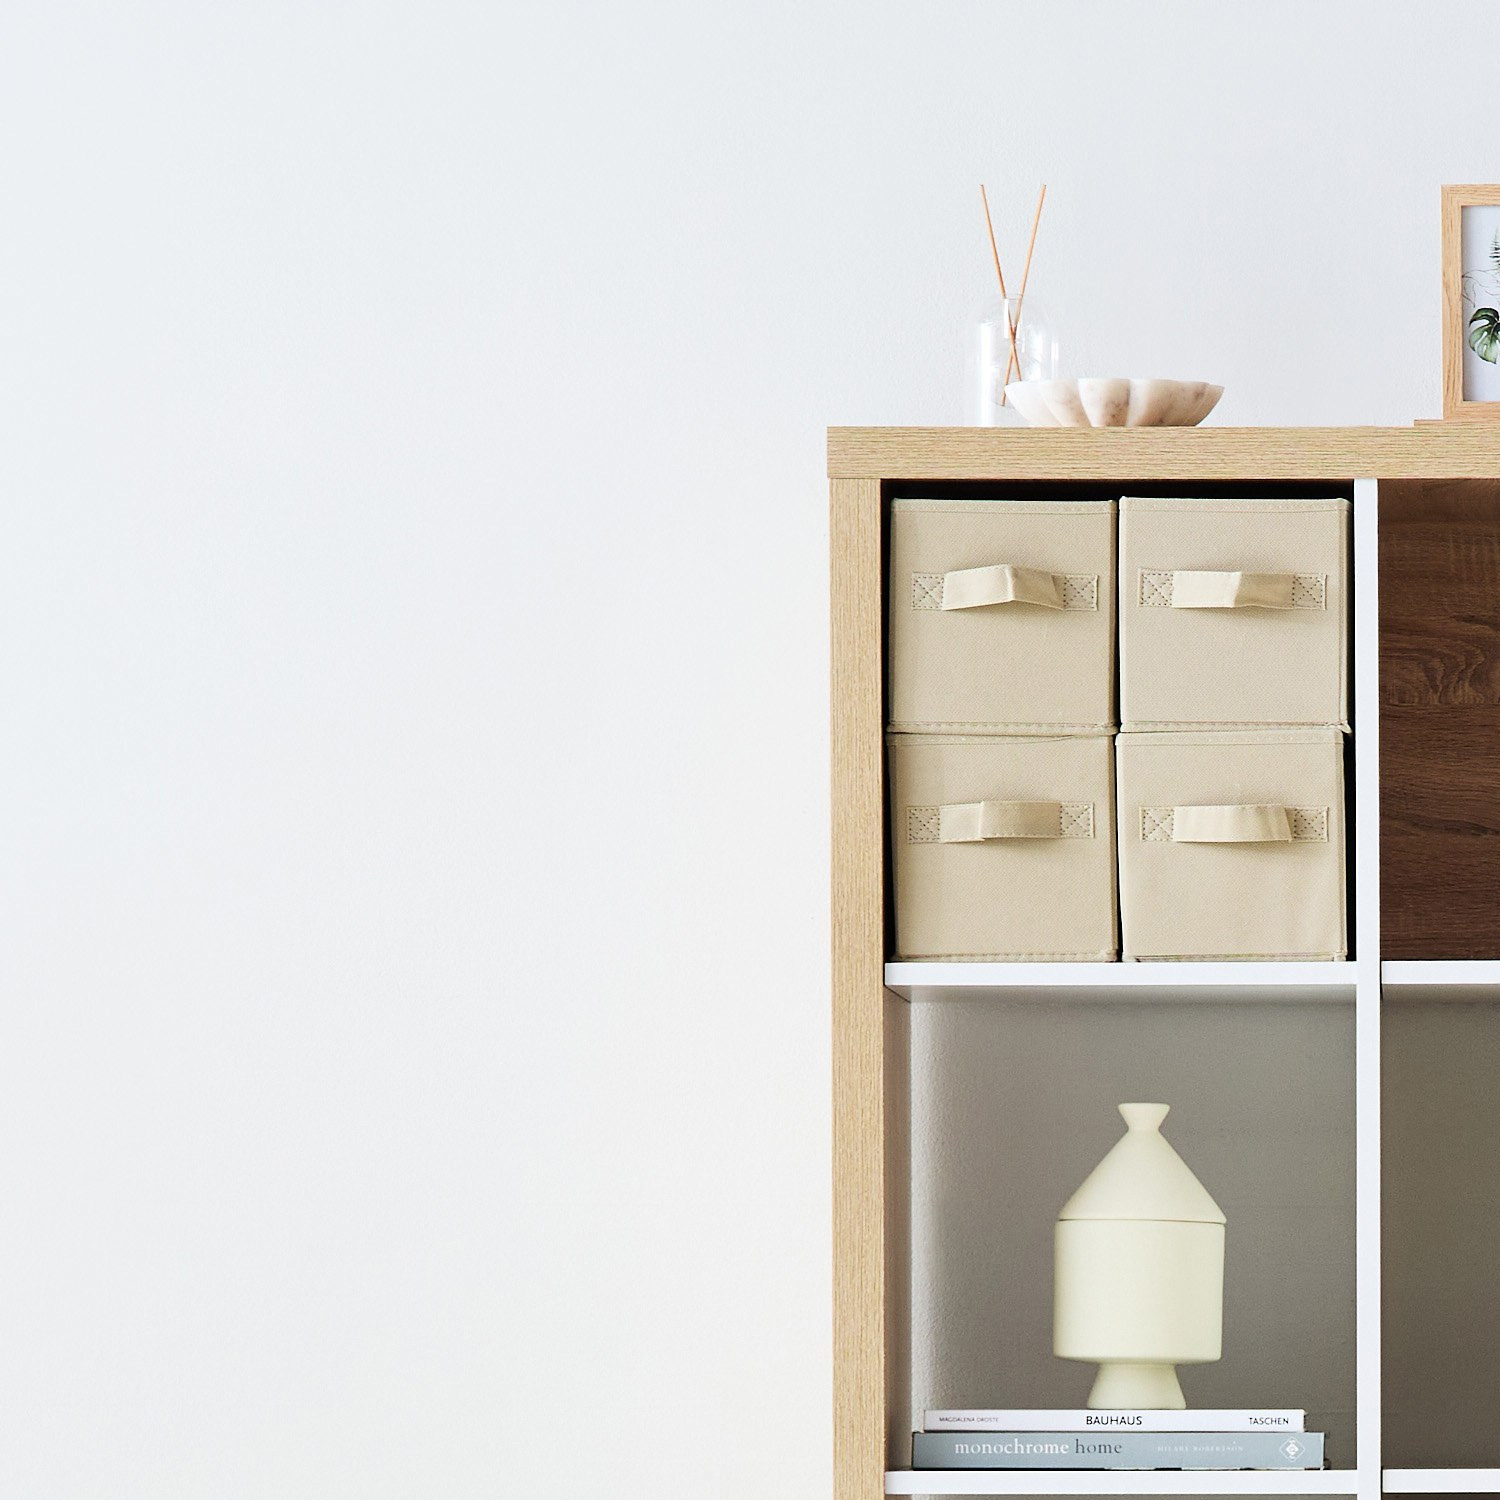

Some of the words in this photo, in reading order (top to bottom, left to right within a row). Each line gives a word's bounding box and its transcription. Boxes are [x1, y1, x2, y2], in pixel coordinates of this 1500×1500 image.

[1086, 1416, 1143, 1426] BAUHAUS
[1249, 1417, 1290, 1426] TASCHEN
[955, 1438, 1070, 1455] monochrome
[1075, 1438, 1123, 1455] home
